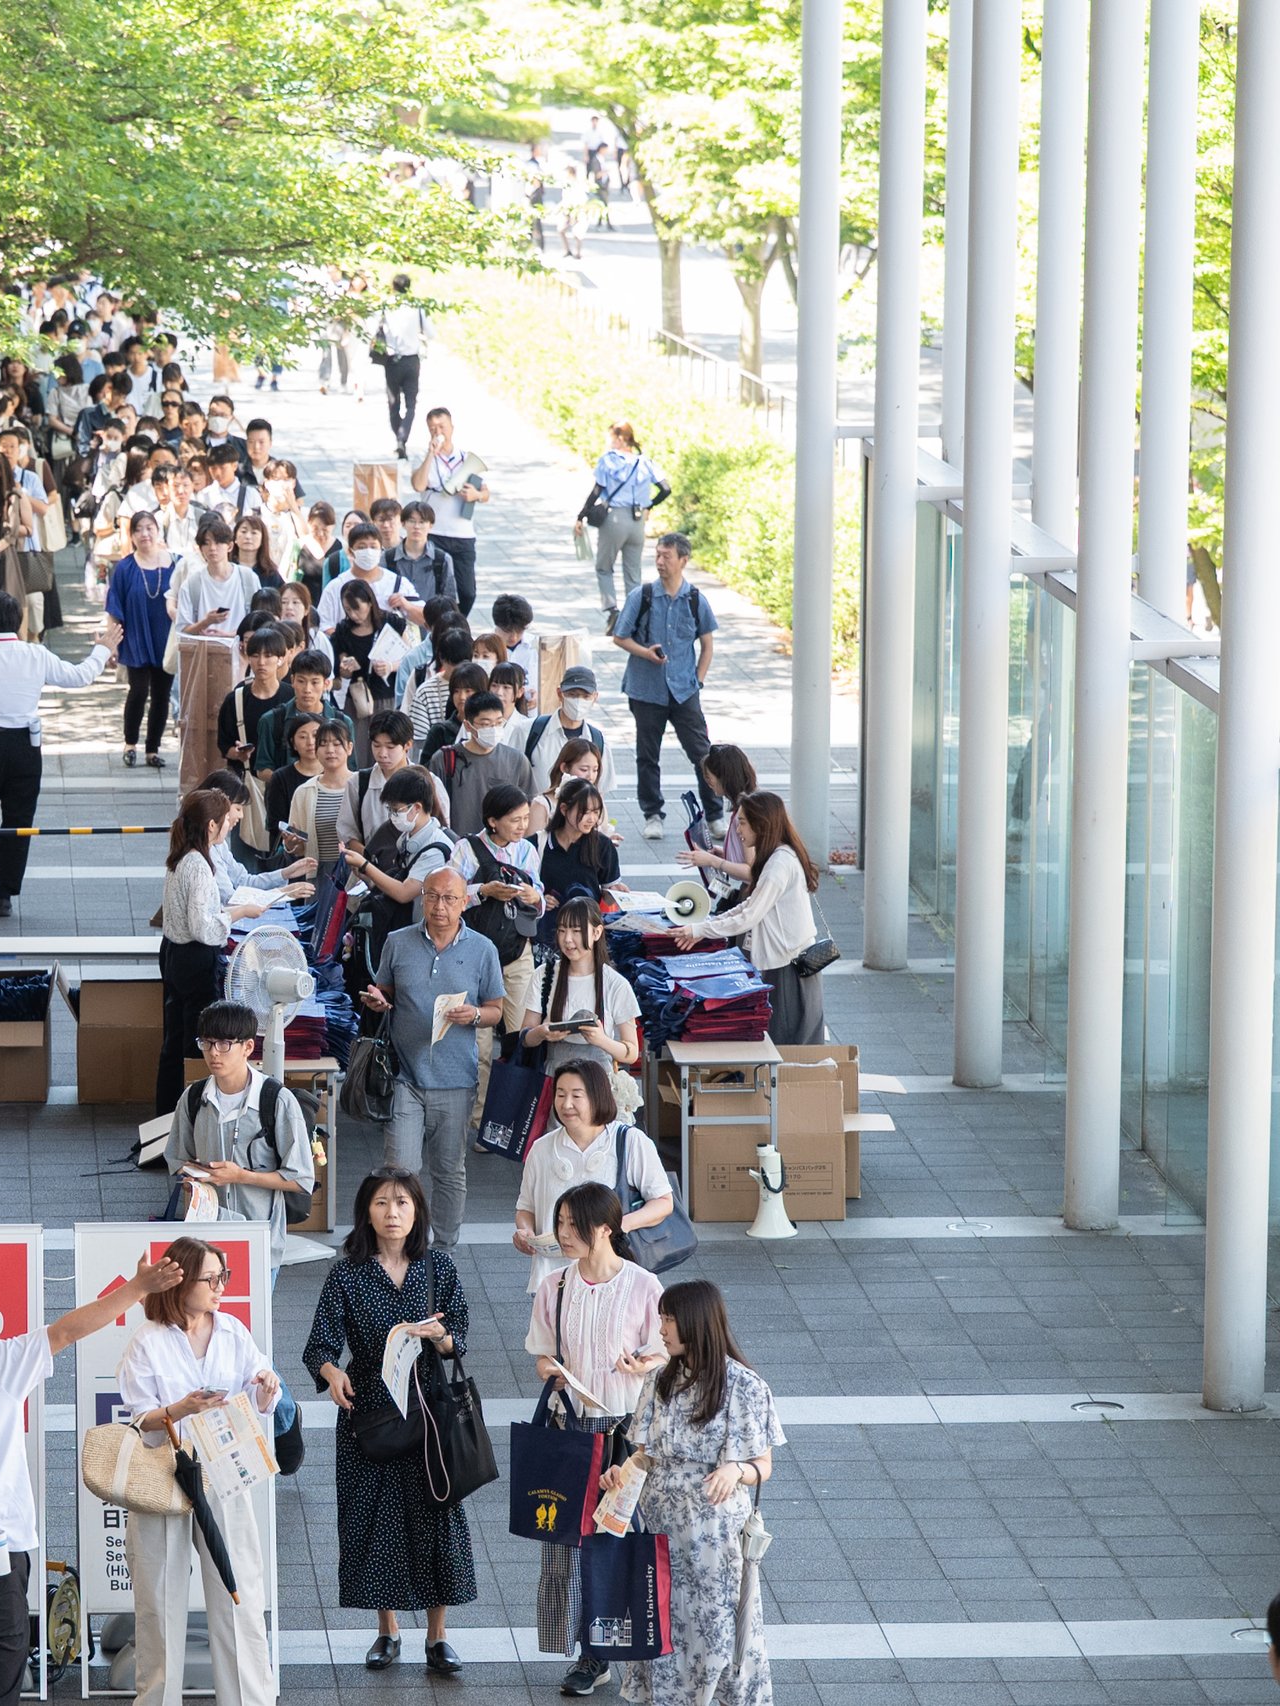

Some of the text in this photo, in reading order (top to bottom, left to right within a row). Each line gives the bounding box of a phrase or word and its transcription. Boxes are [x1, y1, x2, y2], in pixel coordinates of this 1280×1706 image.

[515, 1096, 539, 1155] Keio University
[646, 1563, 655, 1646] Keio University
